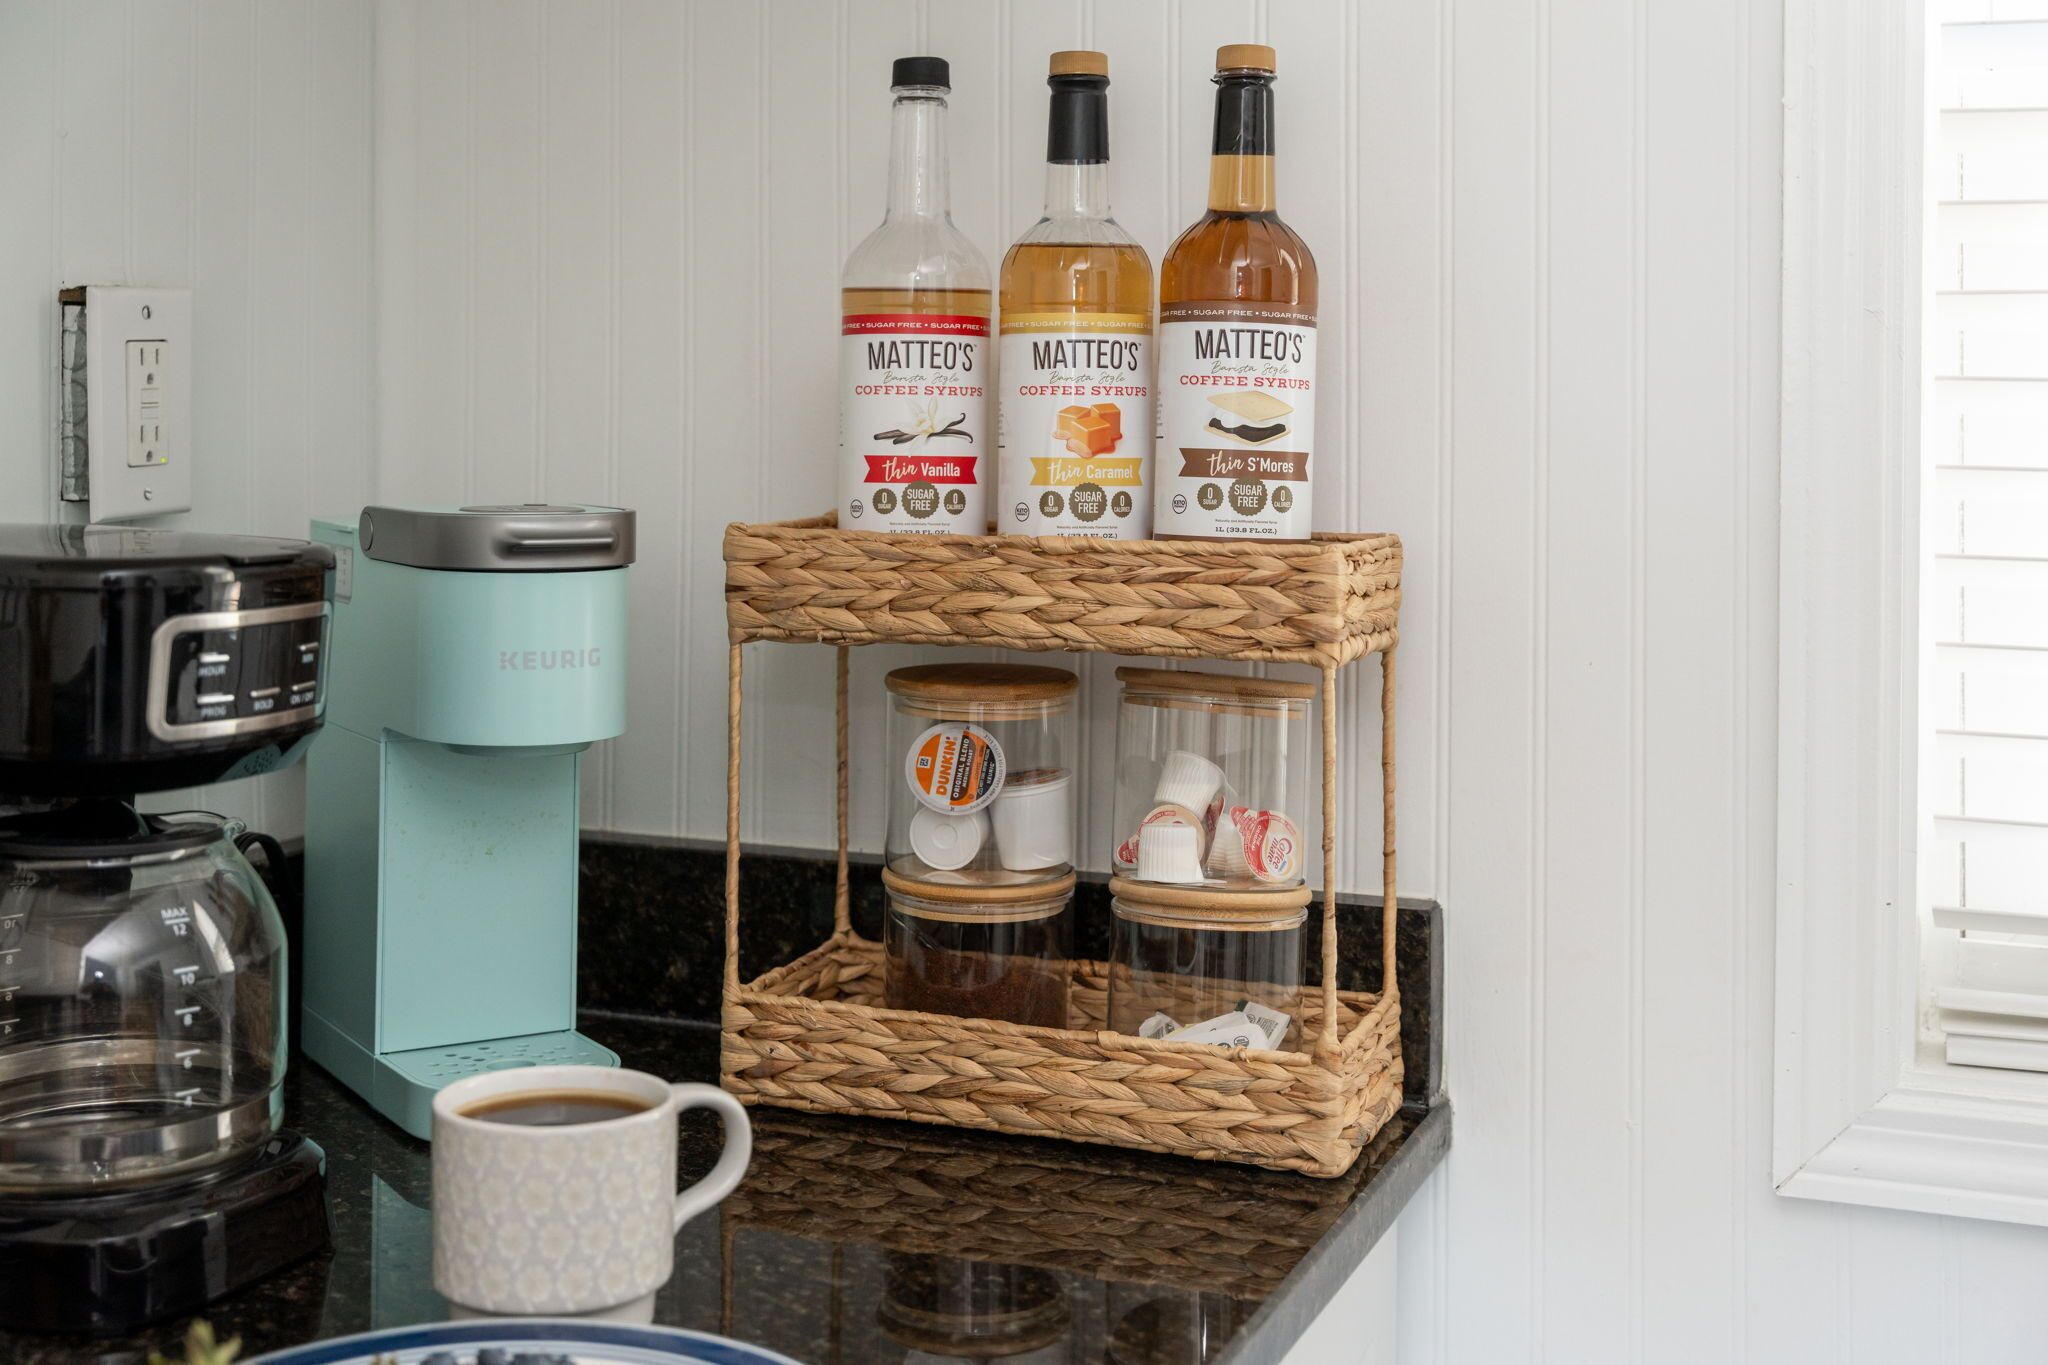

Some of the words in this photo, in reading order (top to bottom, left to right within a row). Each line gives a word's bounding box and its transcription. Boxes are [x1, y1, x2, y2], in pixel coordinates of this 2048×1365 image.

[1261, 311, 1291, 319] SUGAR
[1292, 313, 1309, 321] FREE
[1195, 329, 1302, 363] MATTEO'S
[868, 340, 974, 372] MATTEO'S
[1032, 339, 1138, 371] MATTEO'S
[1211, 360, 1257, 374] Barista
[883, 371, 926, 384] Barista
[1049, 370, 1093, 384] Barista
[1180, 375, 1248, 386] COFFEE
[1253, 377, 1310, 390] SYRUPS
[855, 385, 918, 396] COFFEE
[924, 386, 983, 397] SYRUPS
[1019, 385, 1085, 396] COFFEE
[1091, 386, 1147, 397] SYRUPS
[882, 456, 918, 482] thin
[921, 462, 960, 477] Vanilla
[1206, 450, 1244, 476] thin
[1247, 457, 1294, 473] S'Mores
[1047, 459, 1083, 484] thin
[1086, 464, 1133, 479] Caramel
[906, 488, 935, 500] SUGAR
[1074, 491, 1102, 502] SUGAR
[1207, 487, 1213, 499] 0
[1234, 485, 1263, 496] SUGAR
[1280, 490, 1286, 501] 0
[881, 492, 888, 504] 0
[952, 493, 958, 504] 0
[1048, 495, 1054, 507] 0
[1120, 495, 1125, 507] 0
[1237, 497, 1259, 508] FREE
[910, 501, 931, 511] FREE
[1078, 503, 1099, 514] FREE
[496, 647, 601, 671] KEURIG
[253, 698, 274, 711] BOLD
[953, 764, 965, 798] ORIGINAL
[961, 738, 970, 763] BLEND
[1267, 835, 1279, 864] mate
[1272, 837, 1293, 870] Coffee
[160, 906, 188, 919] MAX
[173, 923, 188, 937] 12
[180, 972, 196, 986] 10
[183, 1013, 193, 1027] 8
